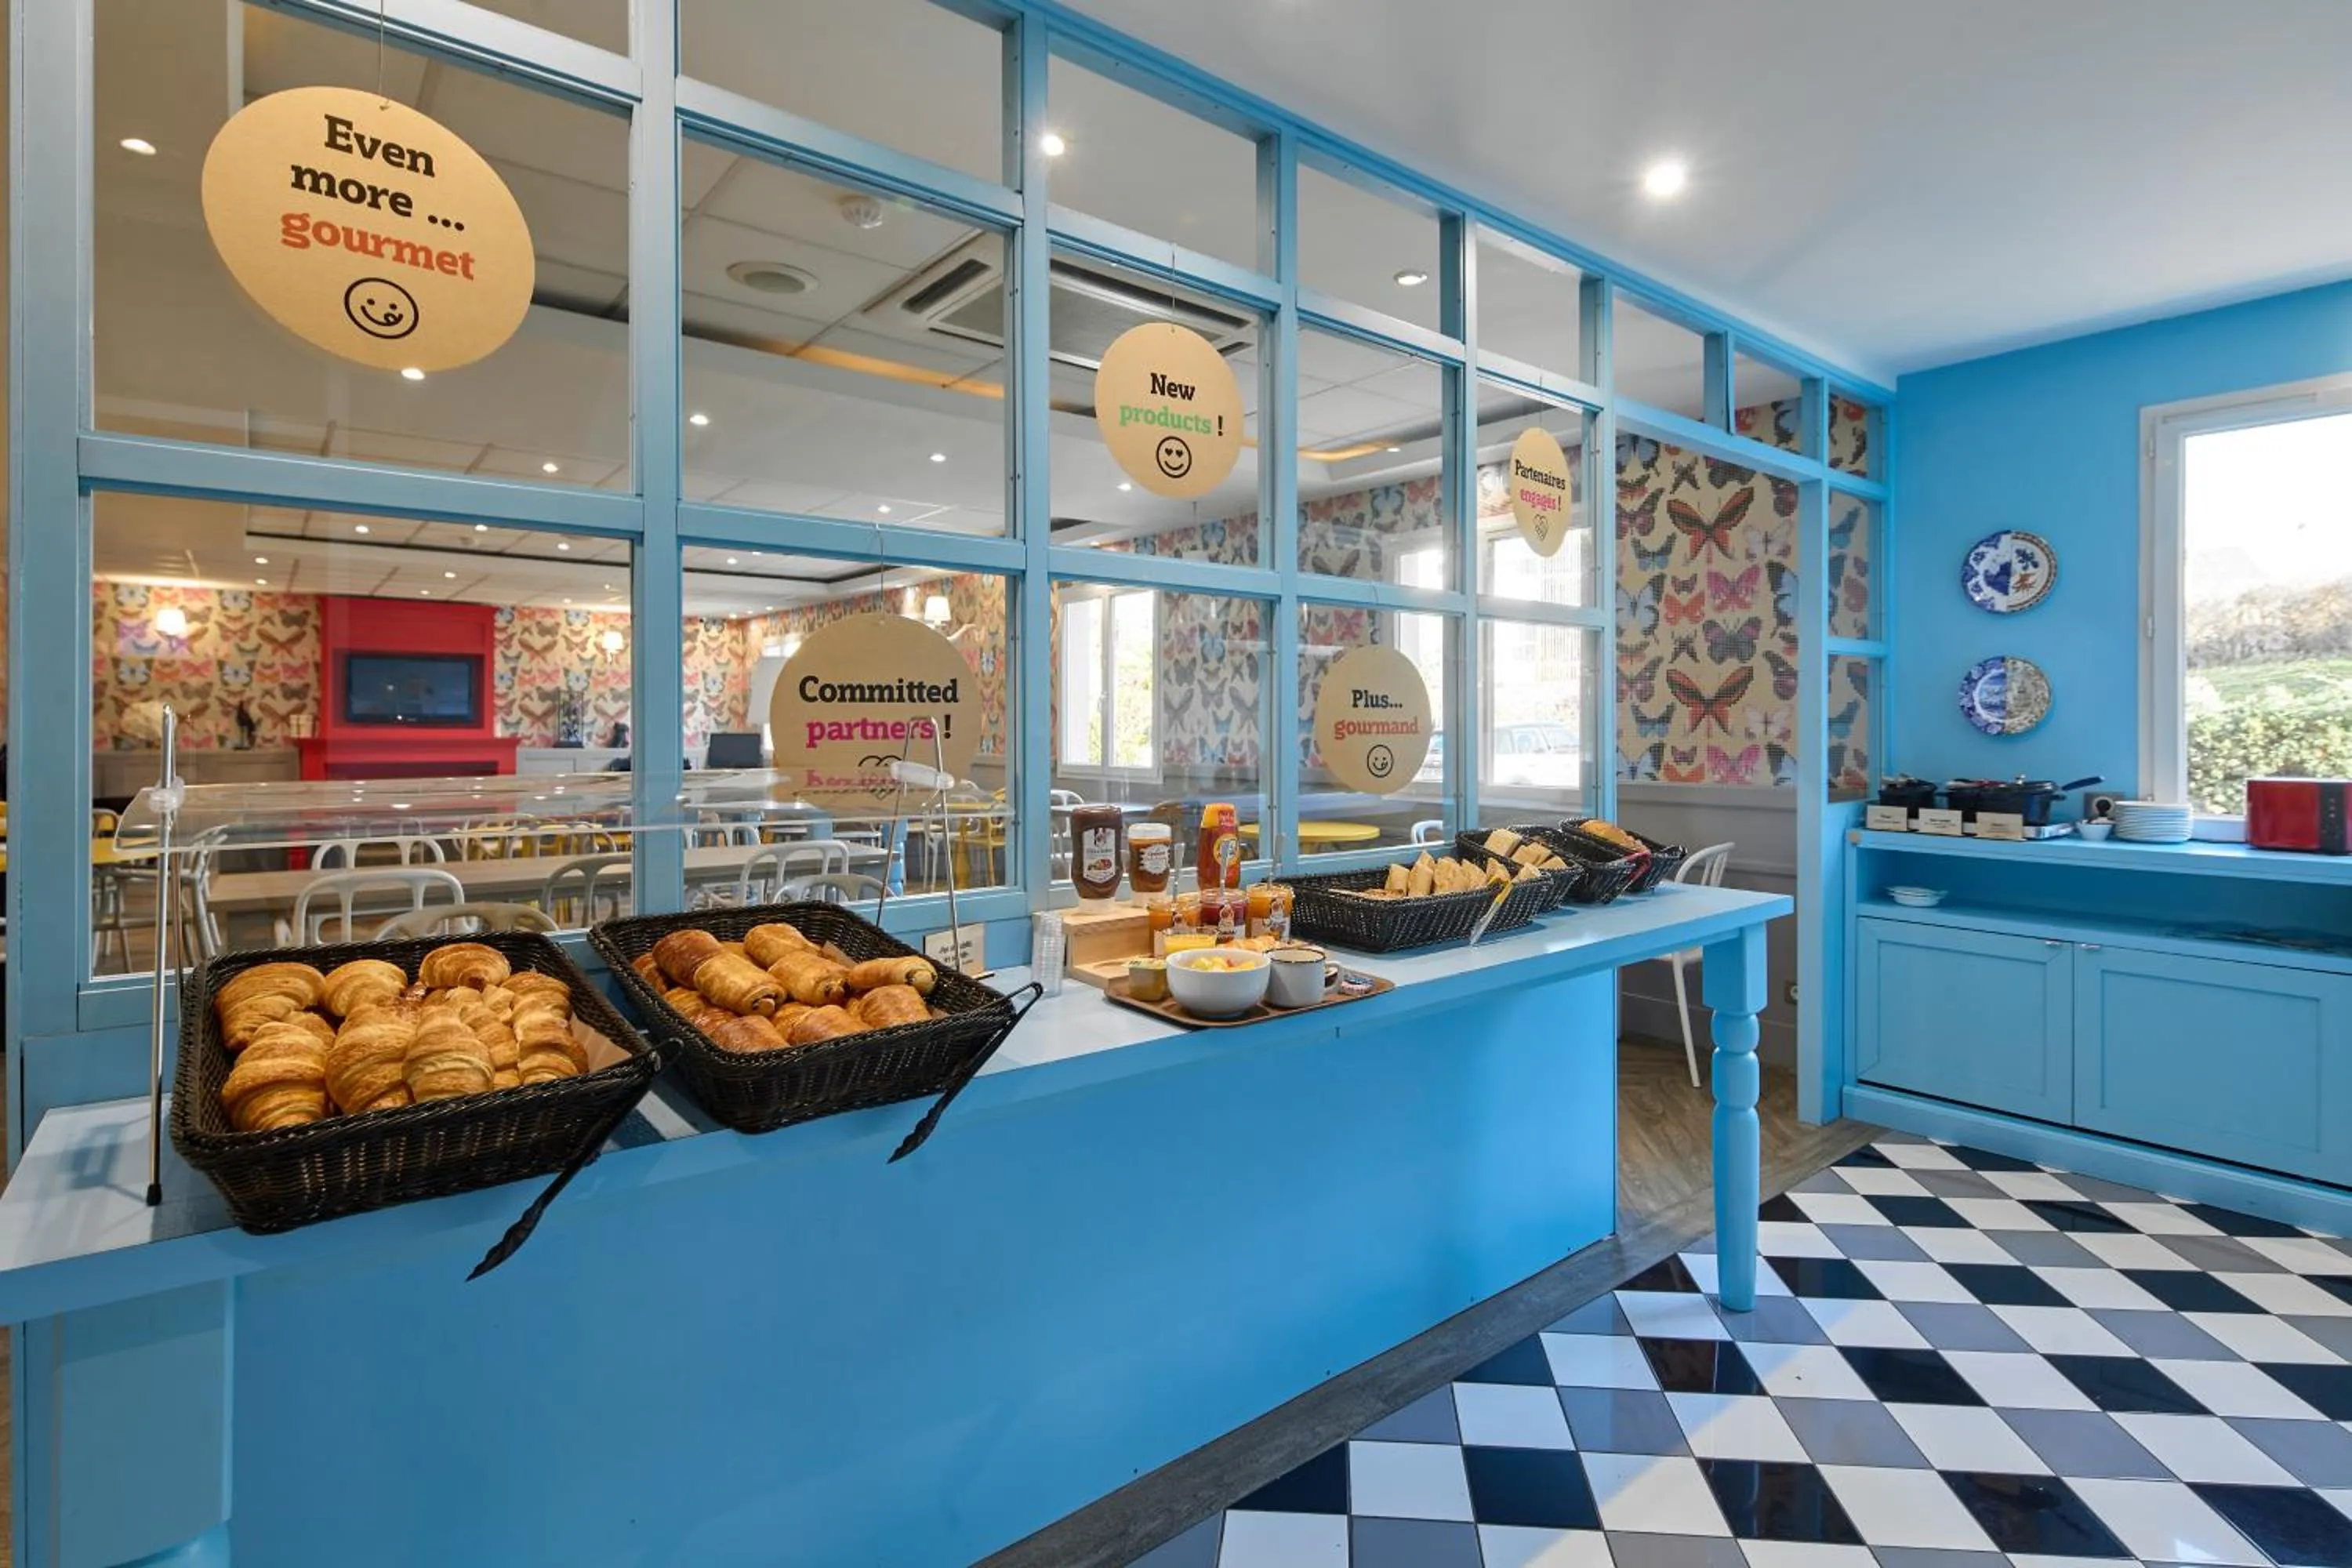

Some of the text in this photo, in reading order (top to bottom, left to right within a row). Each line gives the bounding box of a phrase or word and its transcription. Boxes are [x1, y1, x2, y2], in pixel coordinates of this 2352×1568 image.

[324, 114, 435, 177] Even
[291, 164, 413, 217] more
[281, 212, 475, 280] gourmet
[1150, 372, 1196, 401] New
[1119, 405, 1212, 434] products
[1515, 459, 1566, 490] Partenaires
[799, 675, 960, 703] Committed
[806, 717, 935, 749] partners
[1334, 716, 1419, 740] gourmand
